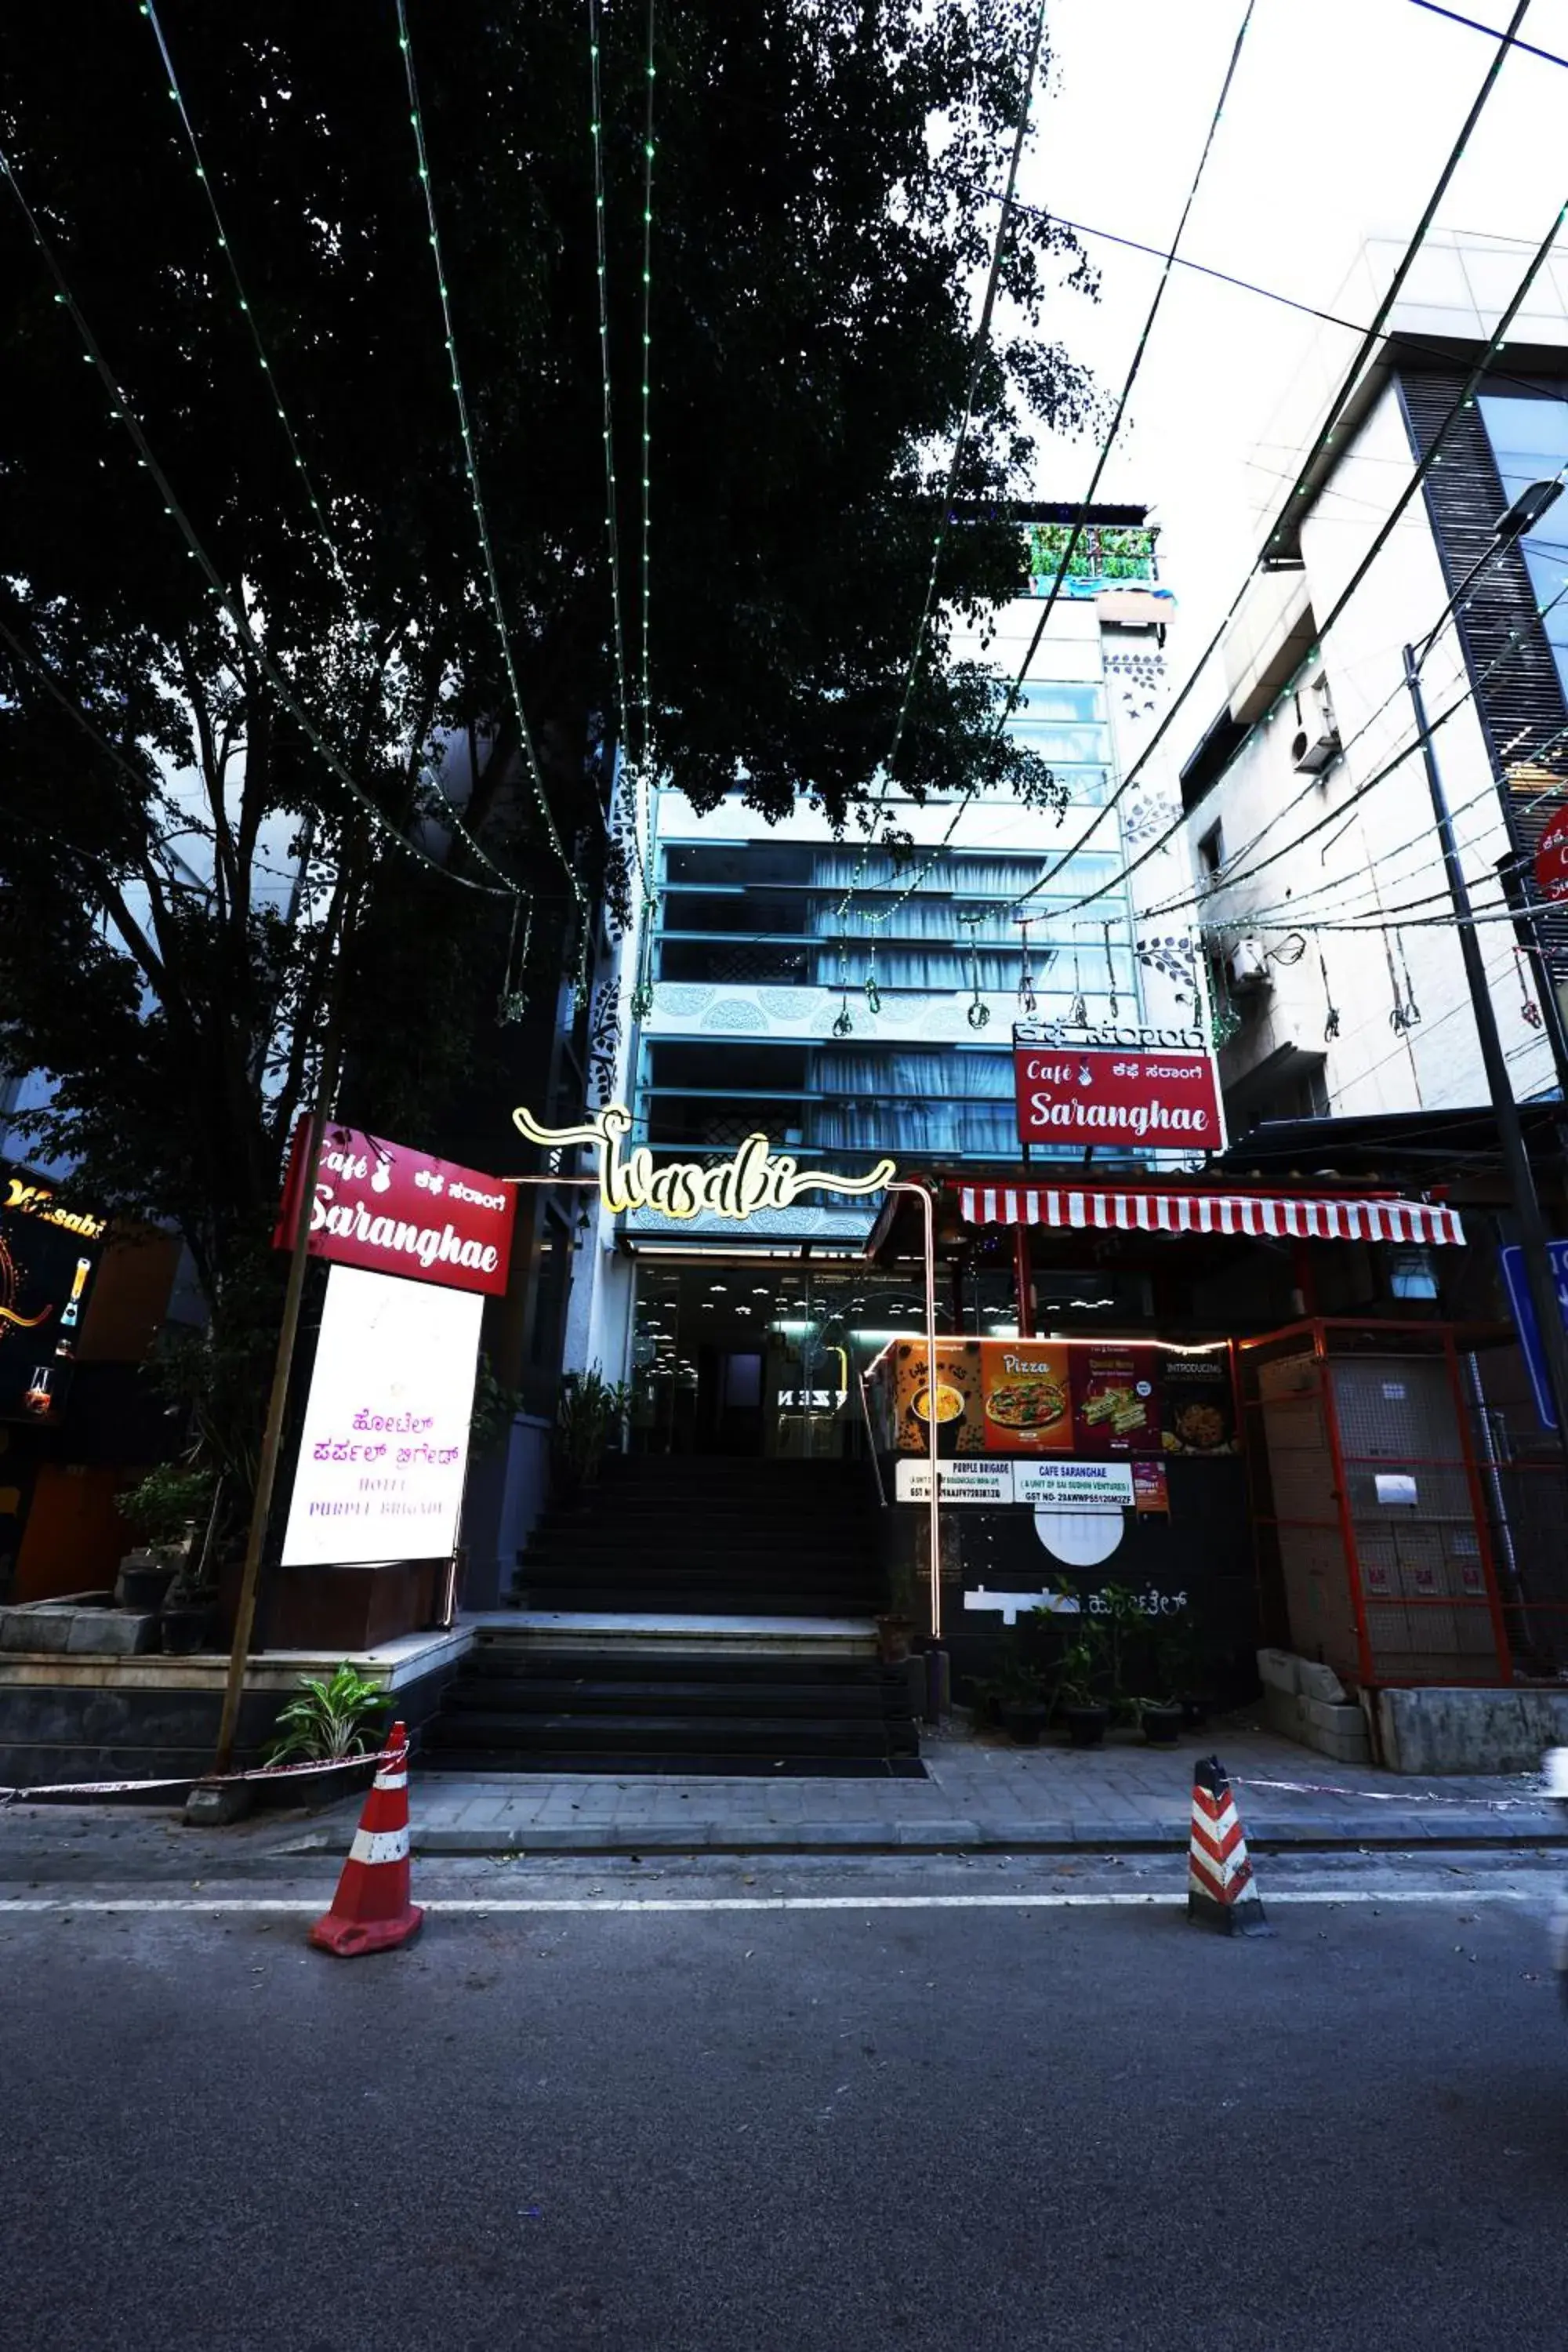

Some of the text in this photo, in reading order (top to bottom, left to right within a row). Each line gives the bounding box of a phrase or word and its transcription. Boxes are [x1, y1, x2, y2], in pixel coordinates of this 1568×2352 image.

[1027, 1060, 1073, 1084] Café
[1030, 1092, 1208, 1137] Saranghae
[310, 1183, 499, 1272] Saranghae
[1003, 1354, 1051, 1374] Pizza
[1039, 1465, 1059, 1477] CAFE
